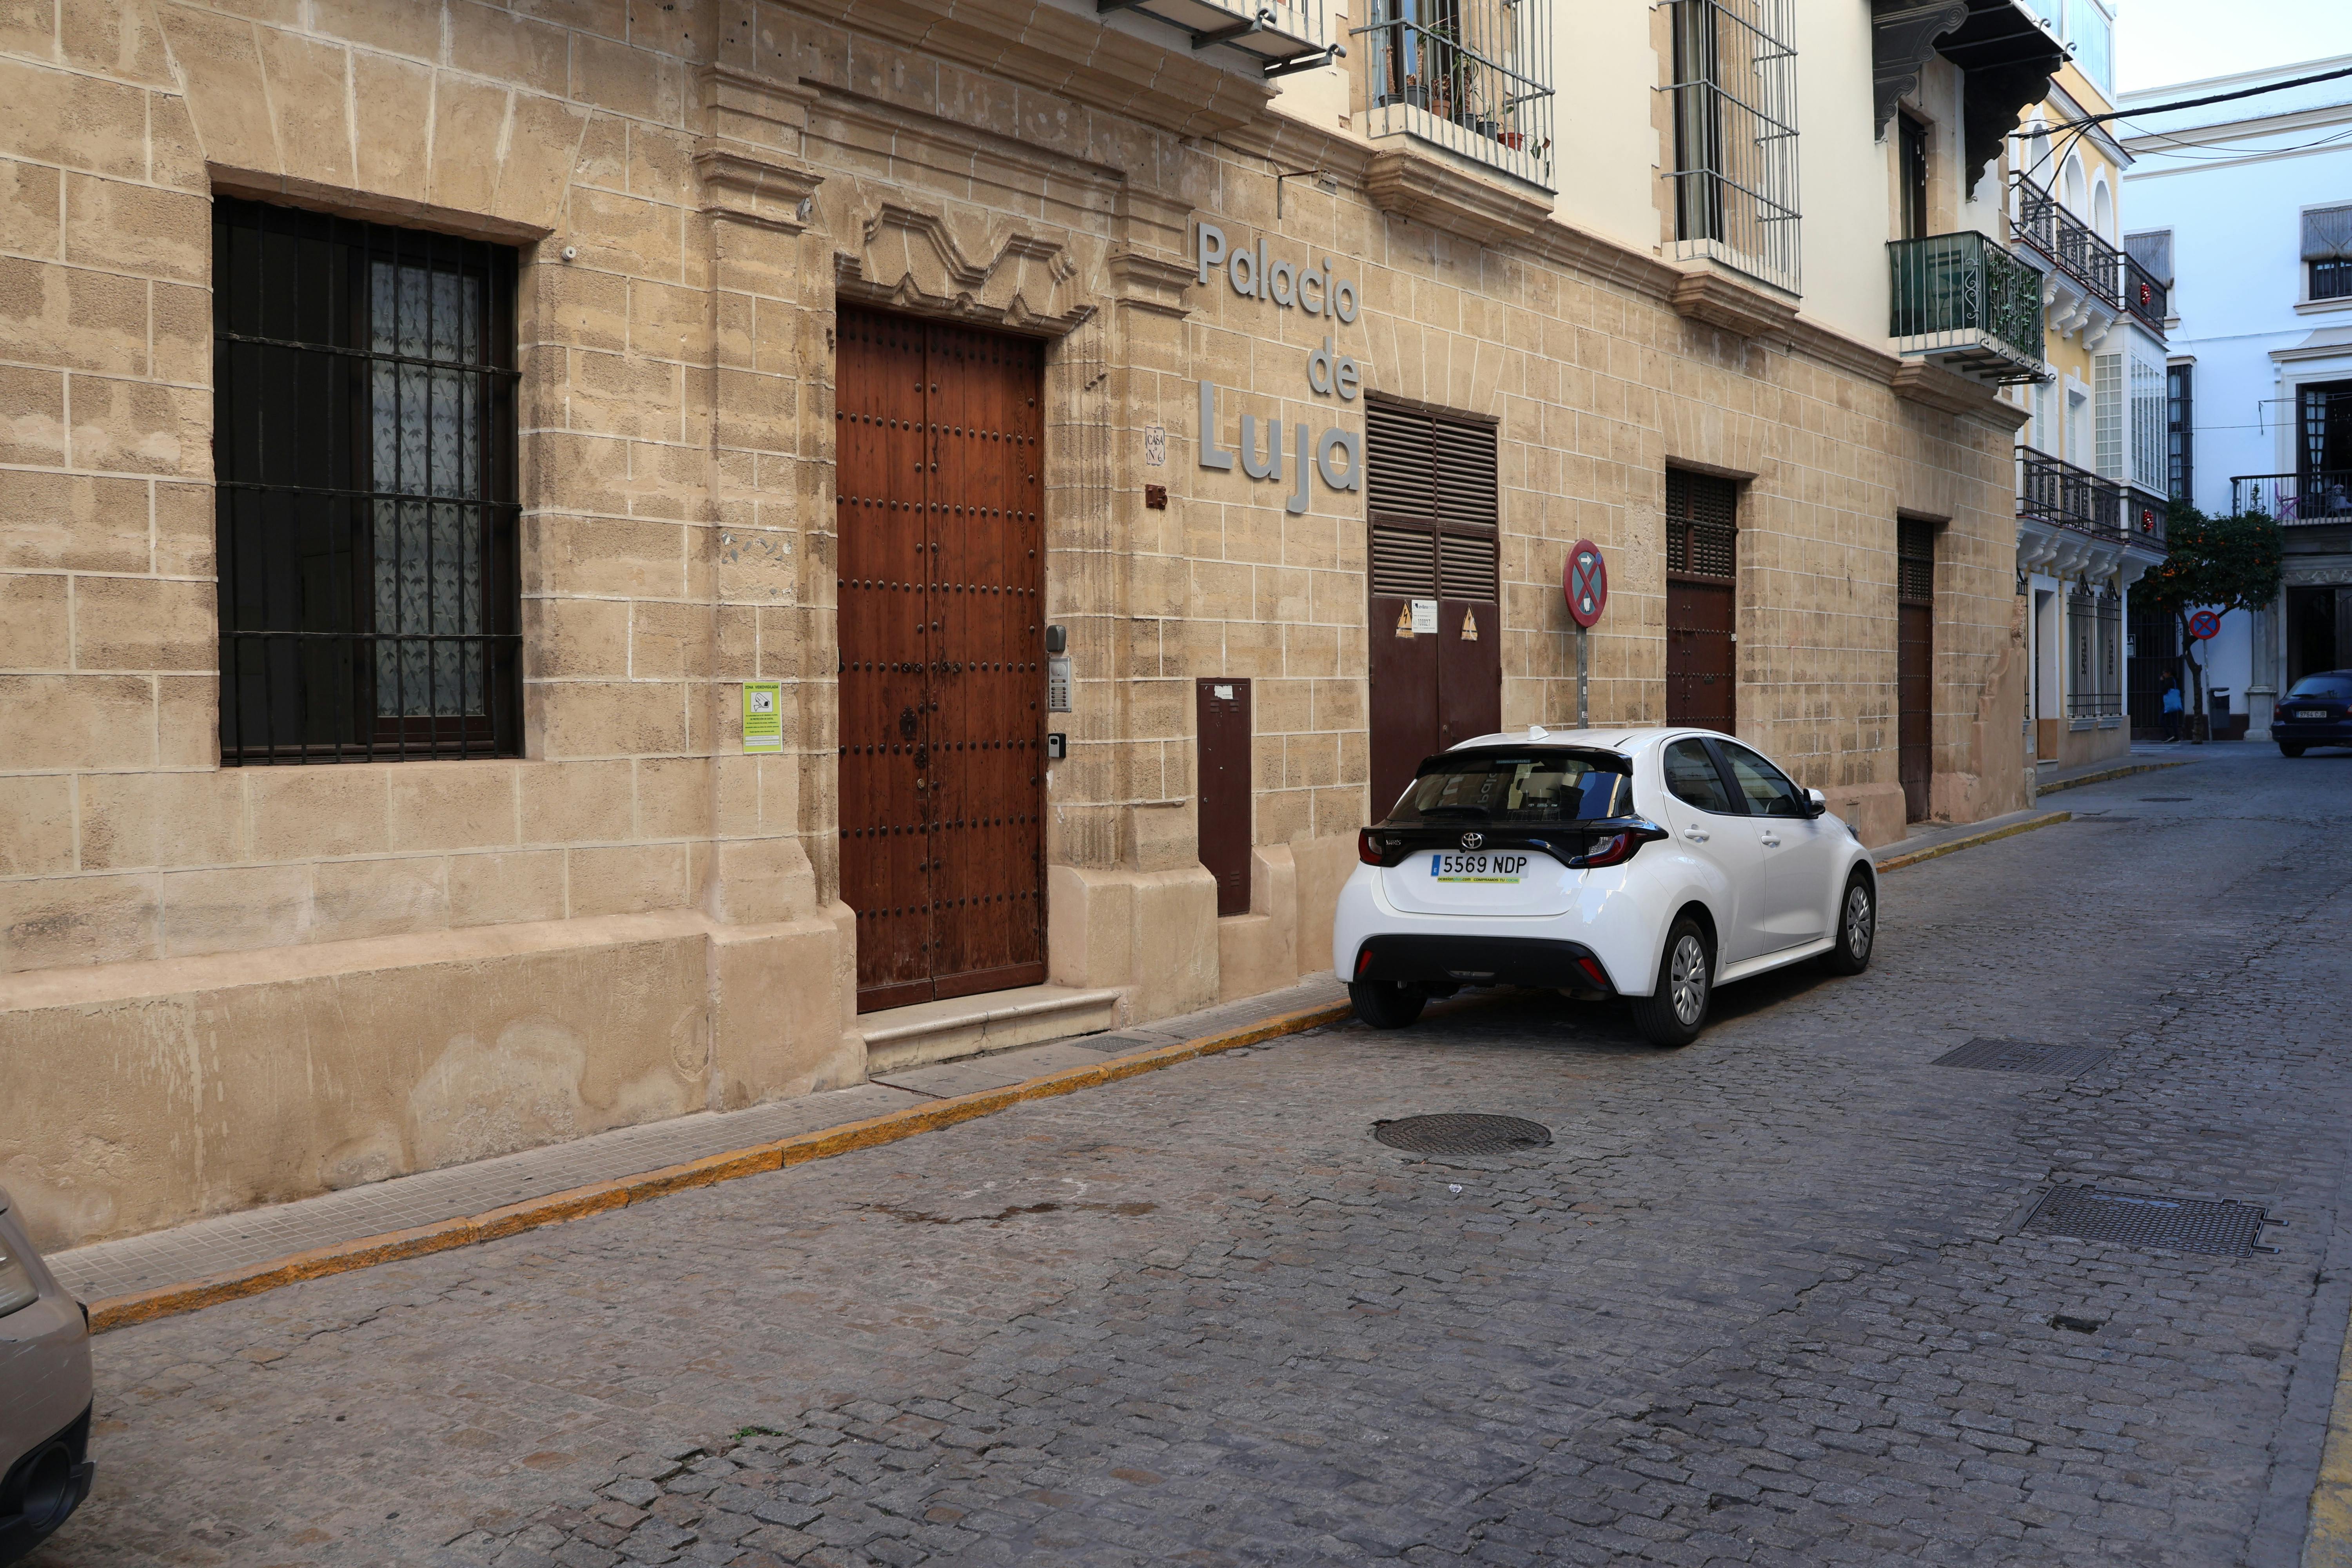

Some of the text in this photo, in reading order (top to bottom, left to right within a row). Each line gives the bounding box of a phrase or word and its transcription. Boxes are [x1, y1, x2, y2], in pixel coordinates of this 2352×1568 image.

[1197, 222, 1358, 323] Palacio
[1307, 336, 1359, 399] de
[1147, 435, 1163, 445] CASA
[1158, 450, 1162, 462] 6
[1199, 379, 1359, 513] Luja
[1443, 856, 1527, 873] 5569 NDP
